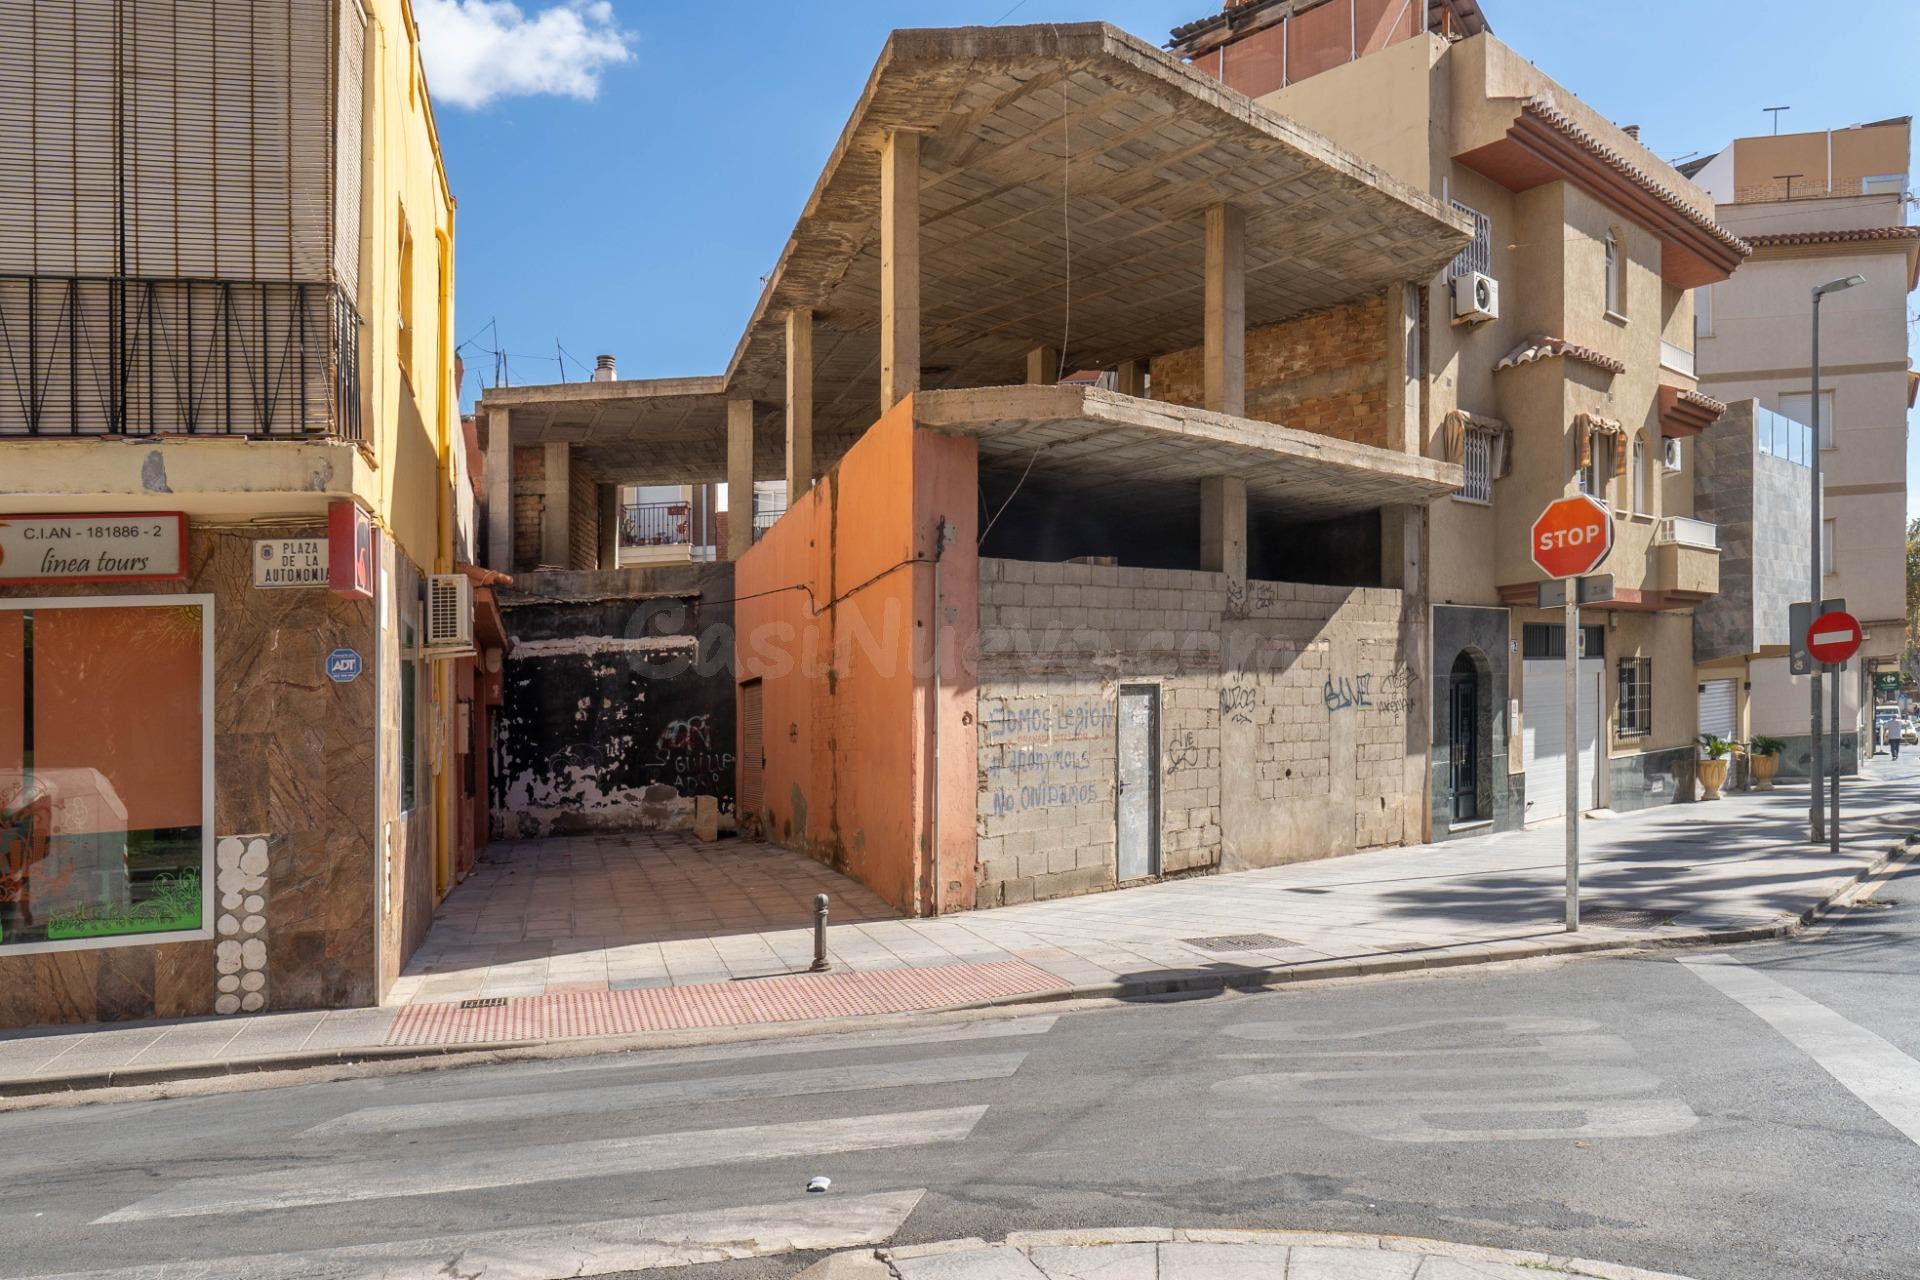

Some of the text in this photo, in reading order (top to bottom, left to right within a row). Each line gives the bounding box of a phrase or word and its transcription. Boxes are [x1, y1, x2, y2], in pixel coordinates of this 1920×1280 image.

[87, 525, 139, 539] 181886
[153, 525, 162, 537] 2
[1539, 524, 1600, 551] STOP
[283, 542, 318, 554] PLAZA
[97, 551, 149, 572] tours
[282, 555, 318, 567] DE LA
[265, 567, 329, 582] AUTONOMIA
[332, 659, 356, 672] ADT
